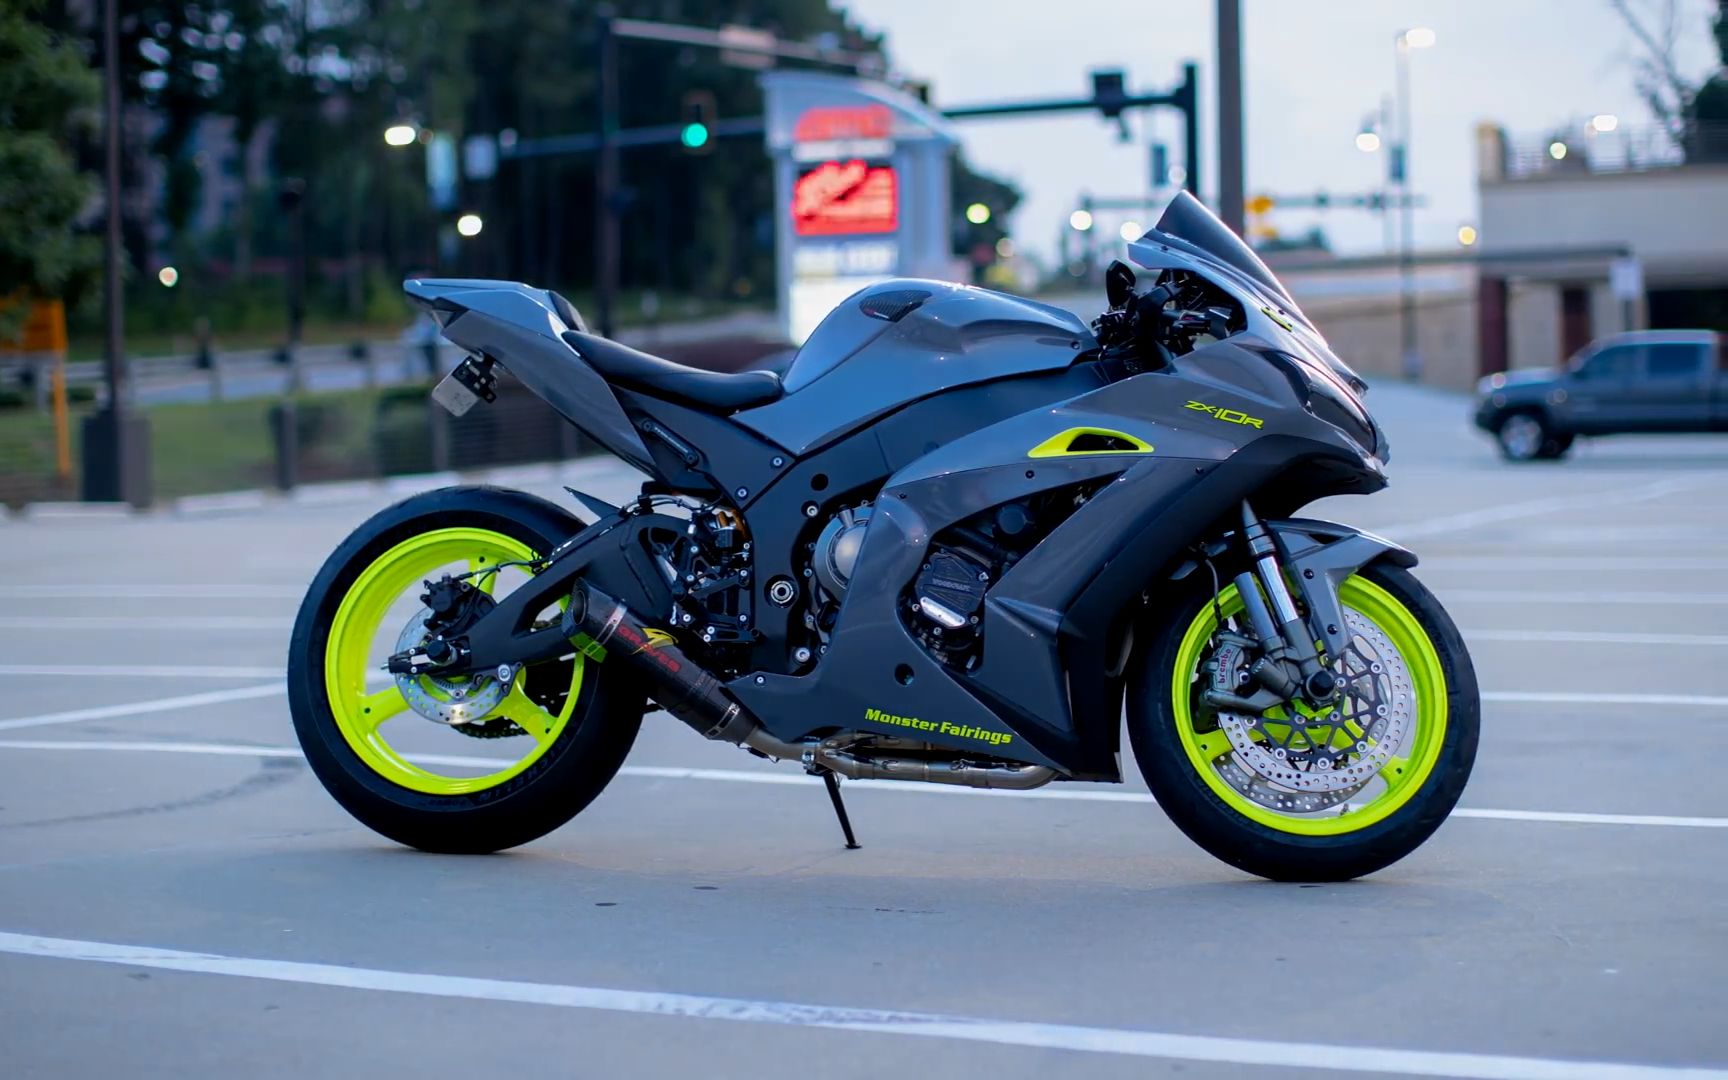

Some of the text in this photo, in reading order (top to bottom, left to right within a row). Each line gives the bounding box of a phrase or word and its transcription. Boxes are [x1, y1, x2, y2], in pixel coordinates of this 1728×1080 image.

[1184, 400, 1264, 429] ZX-10R
[1218, 648, 1232, 684] brembo
[865, 708, 1013, 745] Monster Fairings
